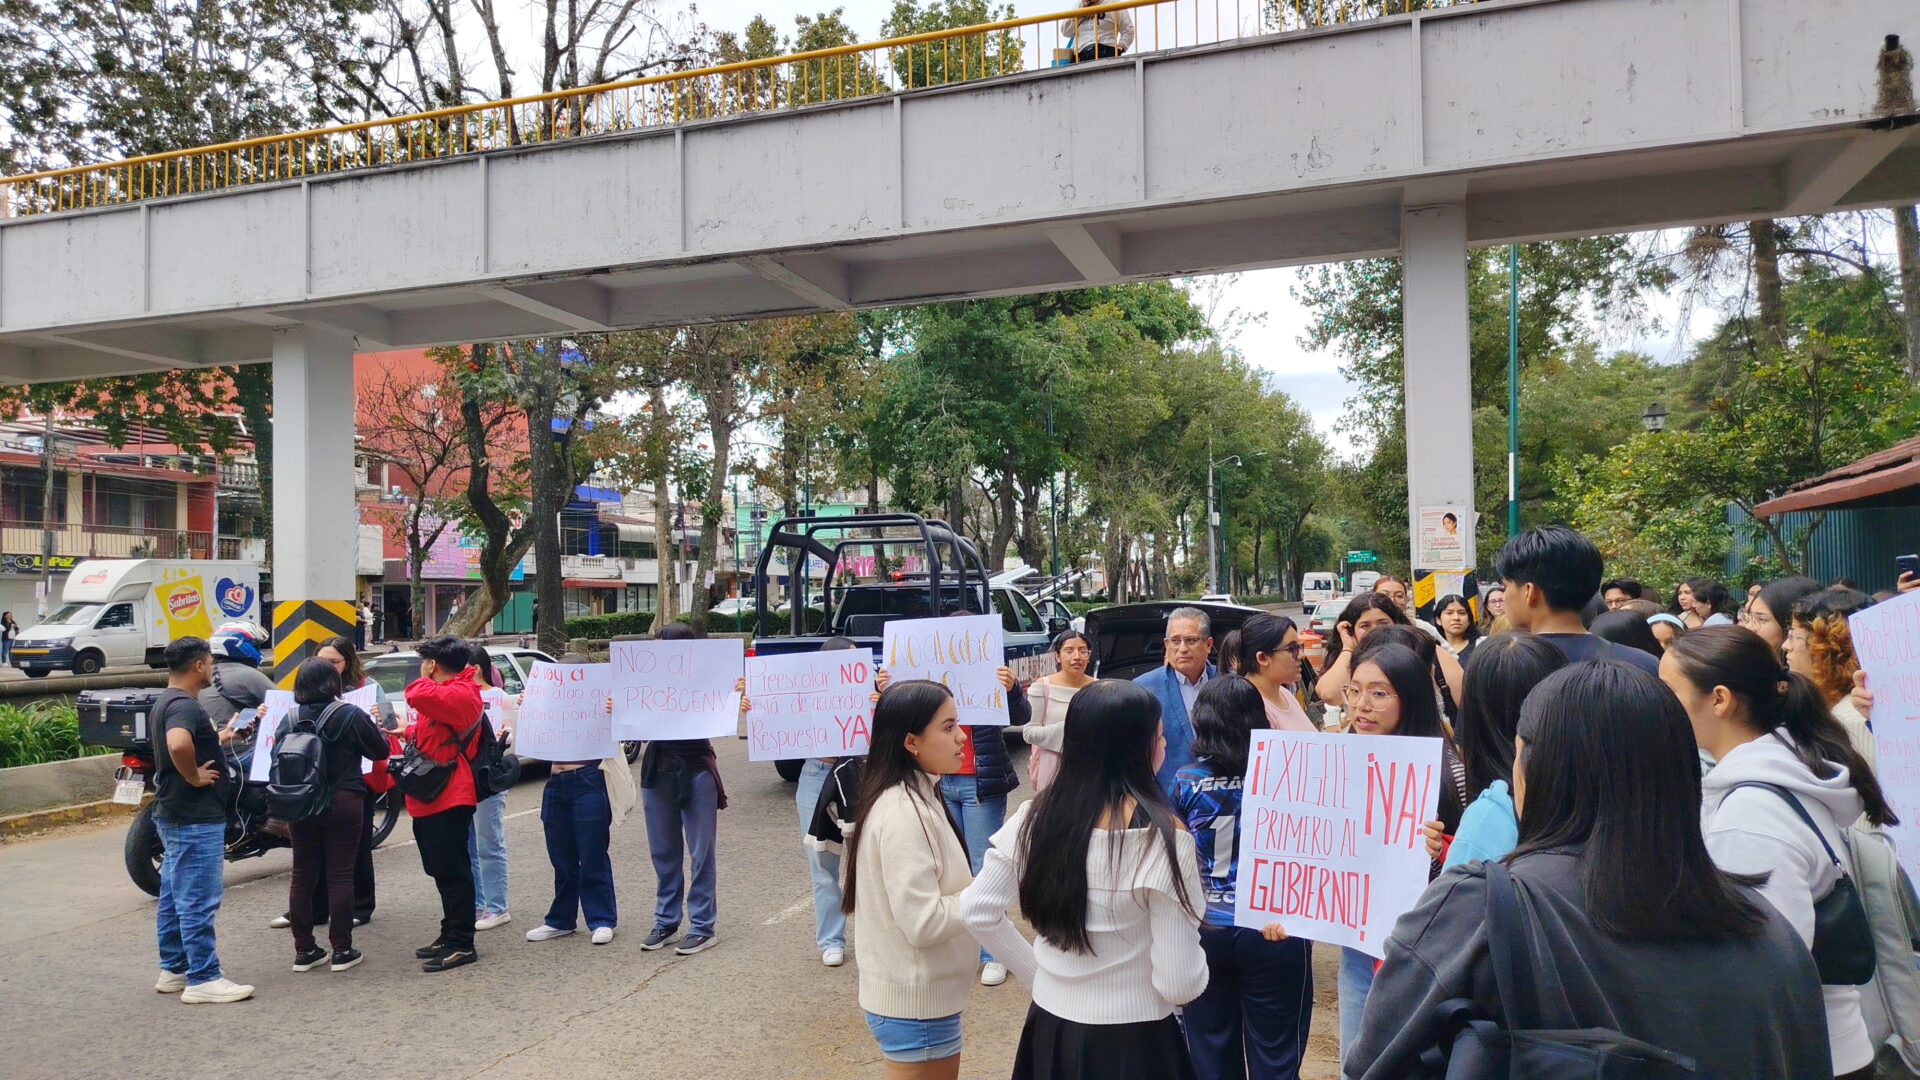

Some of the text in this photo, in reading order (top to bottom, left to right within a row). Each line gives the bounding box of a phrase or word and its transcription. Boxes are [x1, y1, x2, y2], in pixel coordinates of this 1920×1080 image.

[667, 644, 693, 680] al
[748, 659, 868, 694] Preescolar NO
[790, 692, 809, 715] de
[812, 689, 865, 712] acuerdo
[750, 719, 830, 756] Respuesta
[1190, 775, 1246, 794] VERA
[1364, 752, 1432, 850] ¡YA!
[1252, 806, 1360, 858] PRIMERO AL
[1248, 858, 1372, 943] GOBIERNO!
